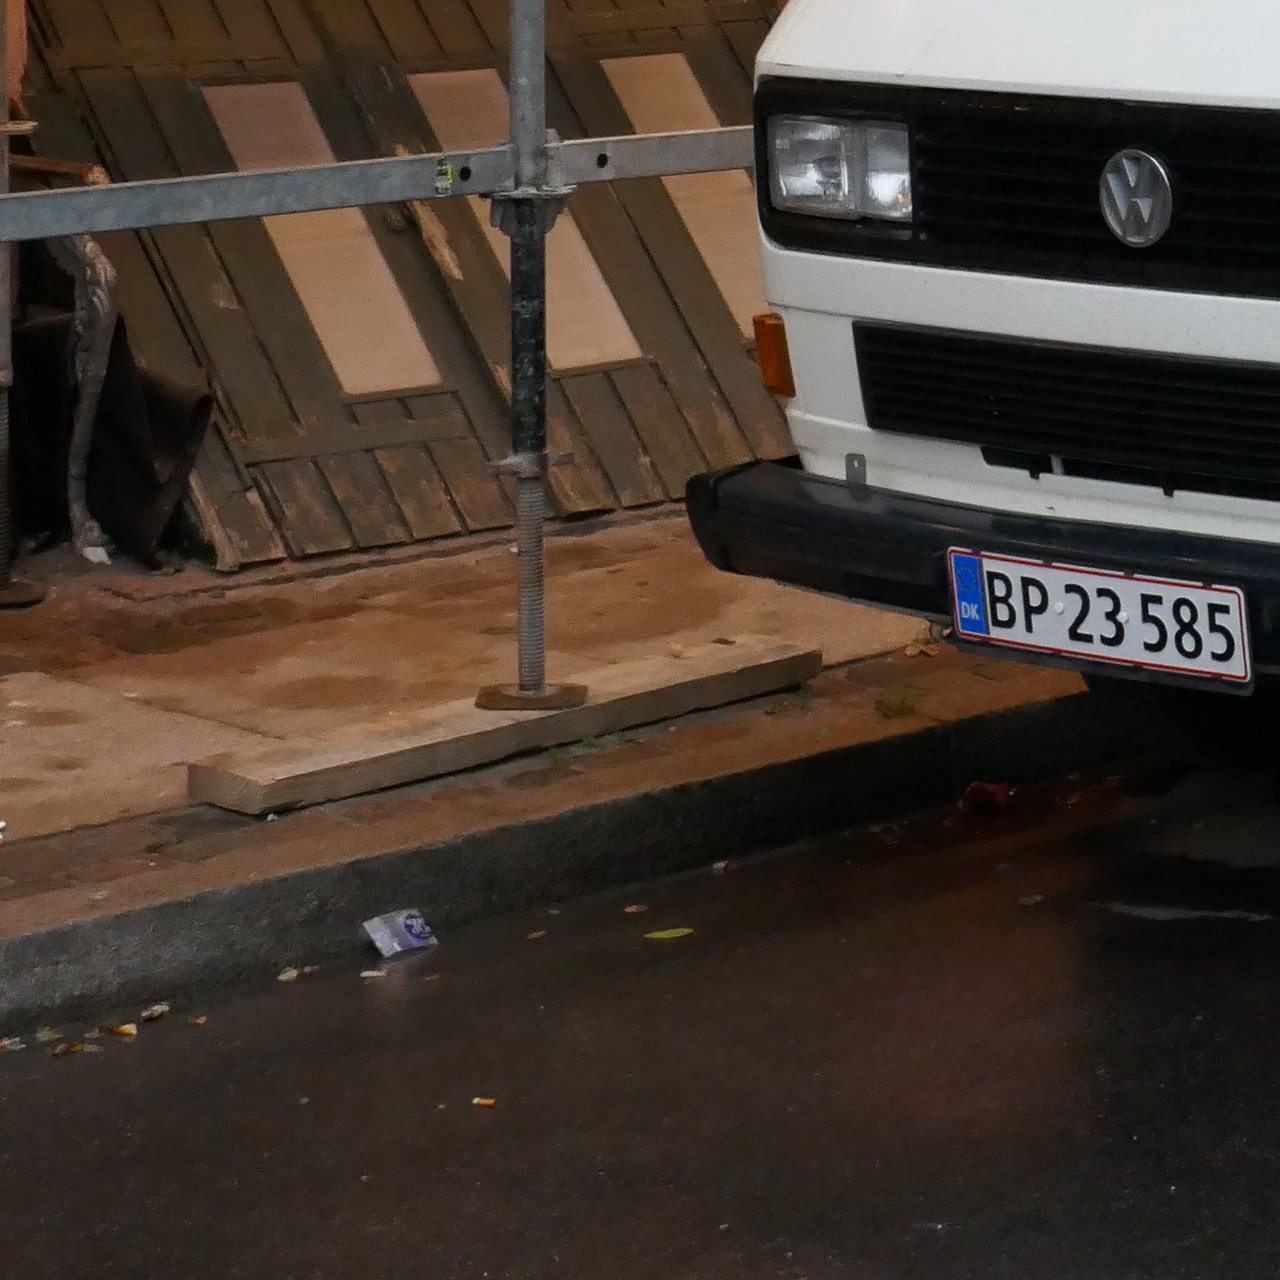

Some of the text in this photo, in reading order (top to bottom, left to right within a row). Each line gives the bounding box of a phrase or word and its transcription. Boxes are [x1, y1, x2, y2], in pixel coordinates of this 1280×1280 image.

[961, 601, 980, 620] DK
[986, 569, 1236, 662] BP 23 585
